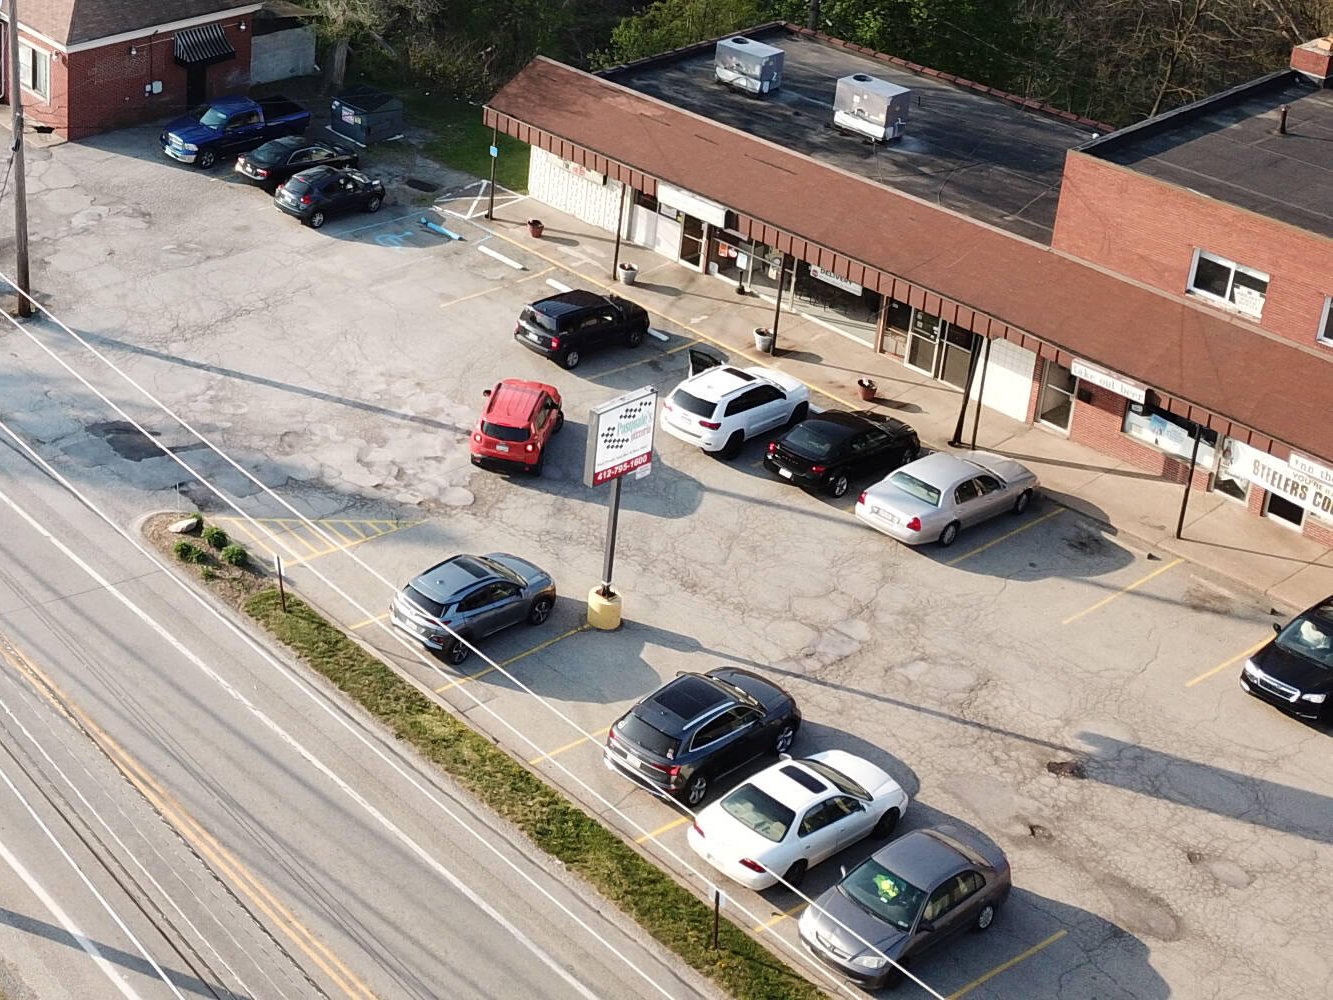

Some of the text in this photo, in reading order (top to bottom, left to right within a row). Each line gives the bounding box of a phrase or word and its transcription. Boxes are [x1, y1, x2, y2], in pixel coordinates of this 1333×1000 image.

[1073, 364, 1143, 401] take out beer
[597, 454, 647, 481] 412-795-1600
[1292, 470, 1324, 491] YOU'RE
